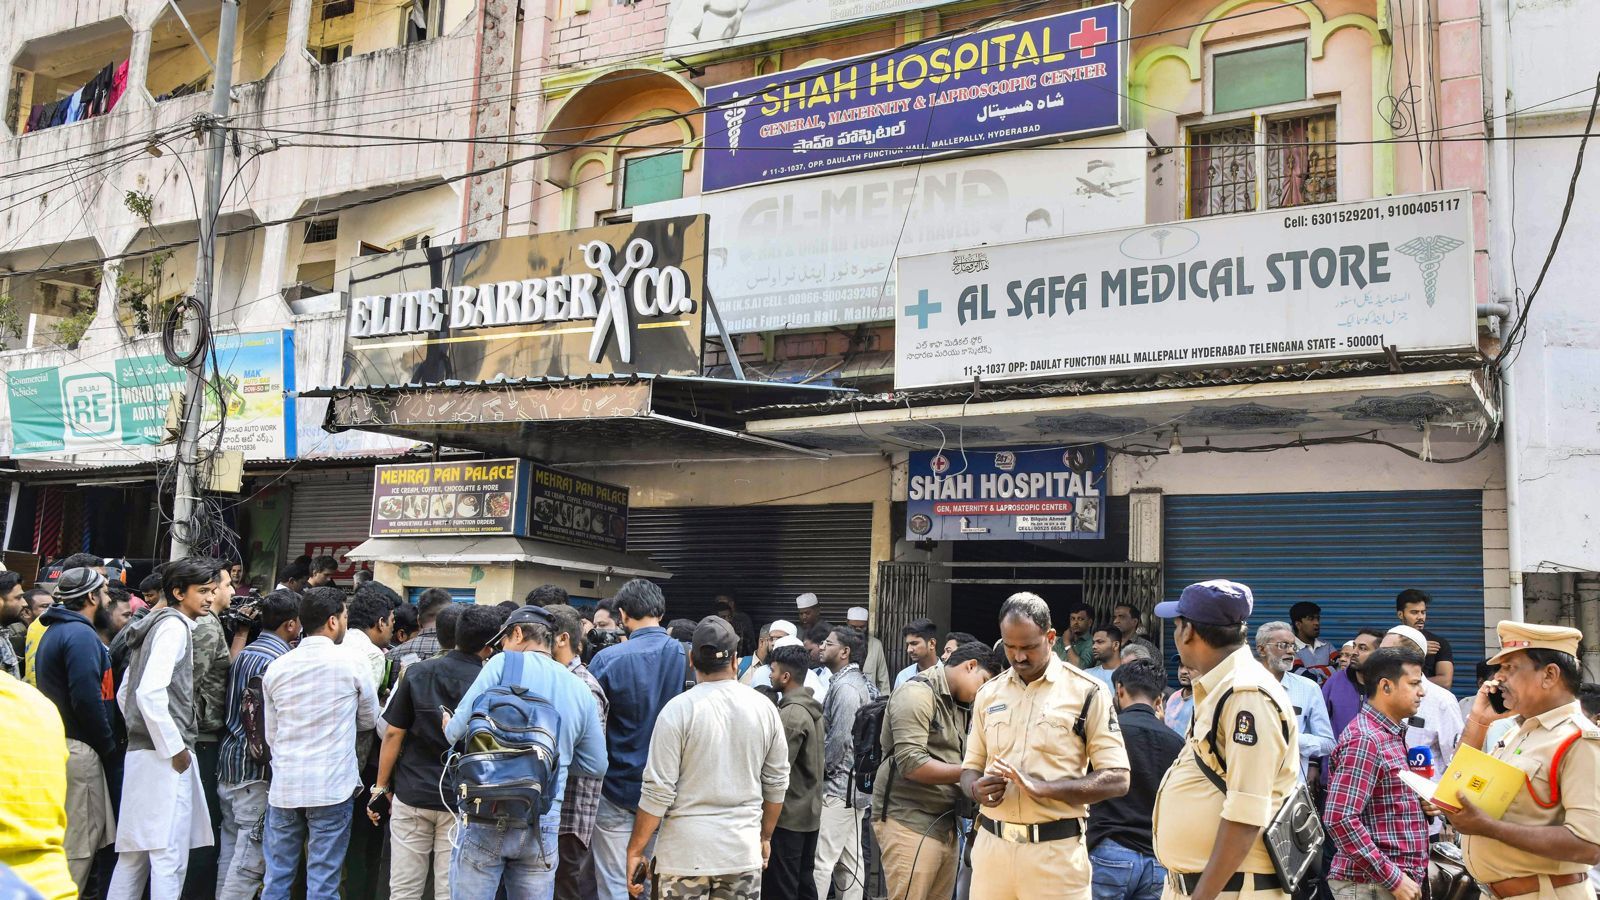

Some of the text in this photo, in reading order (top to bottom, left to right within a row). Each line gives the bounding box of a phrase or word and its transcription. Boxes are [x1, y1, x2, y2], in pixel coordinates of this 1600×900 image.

[761, 27, 1066, 117] SHAH HOSPITAL
[759, 62, 1107, 138] GENERAL, MATERNITY & LAPROSCOPIC CENTER
[770, 163, 806, 176] 11-3-1037,
[808, 160, 825, 169] OPP.
[827, 153, 861, 166] DAULATH
[863, 147, 904, 161] FUNCTION
[931, 133, 985, 148] MALLEPALLY,
[987, 124, 1041, 139] HYDERABAD
[1284, 199, 1461, 229] Cell: 6301529201, 9100405117
[957, 241, 1392, 327] AL SAFA MEDICAL STORE
[350, 266, 693, 339] ELITE BARBER CO.
[963, 363, 1006, 376] 11-3-1037
[1008, 362, 1028, 373] OPP:
[1030, 358, 1061, 371] DAULAT
[1064, 355, 1106, 369] FUNCTION
[1109, 353, 1131, 365] HALL
[1133, 349, 1188, 362] MALLEPALLY
[1191, 345, 1246, 359] HYDERABAD
[1249, 340, 1304, 355] TELENGANA
[1307, 337, 1336, 351] STATE
[1347, 334, 1384, 348] 500001
[11, 372, 49, 385] Commercial
[244, 369, 261, 378] MAK
[12, 386, 38, 397] Vehicles
[78, 385, 100, 393] BAJAJ
[72, 393, 109, 425] RE
[260, 424, 277, 432] WORK
[380, 465, 514, 486] MEHRAJ PAN PALACE
[444, 484, 476, 492] CHOCOLATE
[536, 469, 627, 505] MEHRAJ PAN PALACE
[909, 471, 1100, 501] SHAH HOSPITAL
[936, 505, 951, 513] GEN,
[952, 504, 988, 512] MATERNITY
[996, 503, 1040, 511] LAPROSCOPIC
[1041, 503, 1068, 511] CENTER
